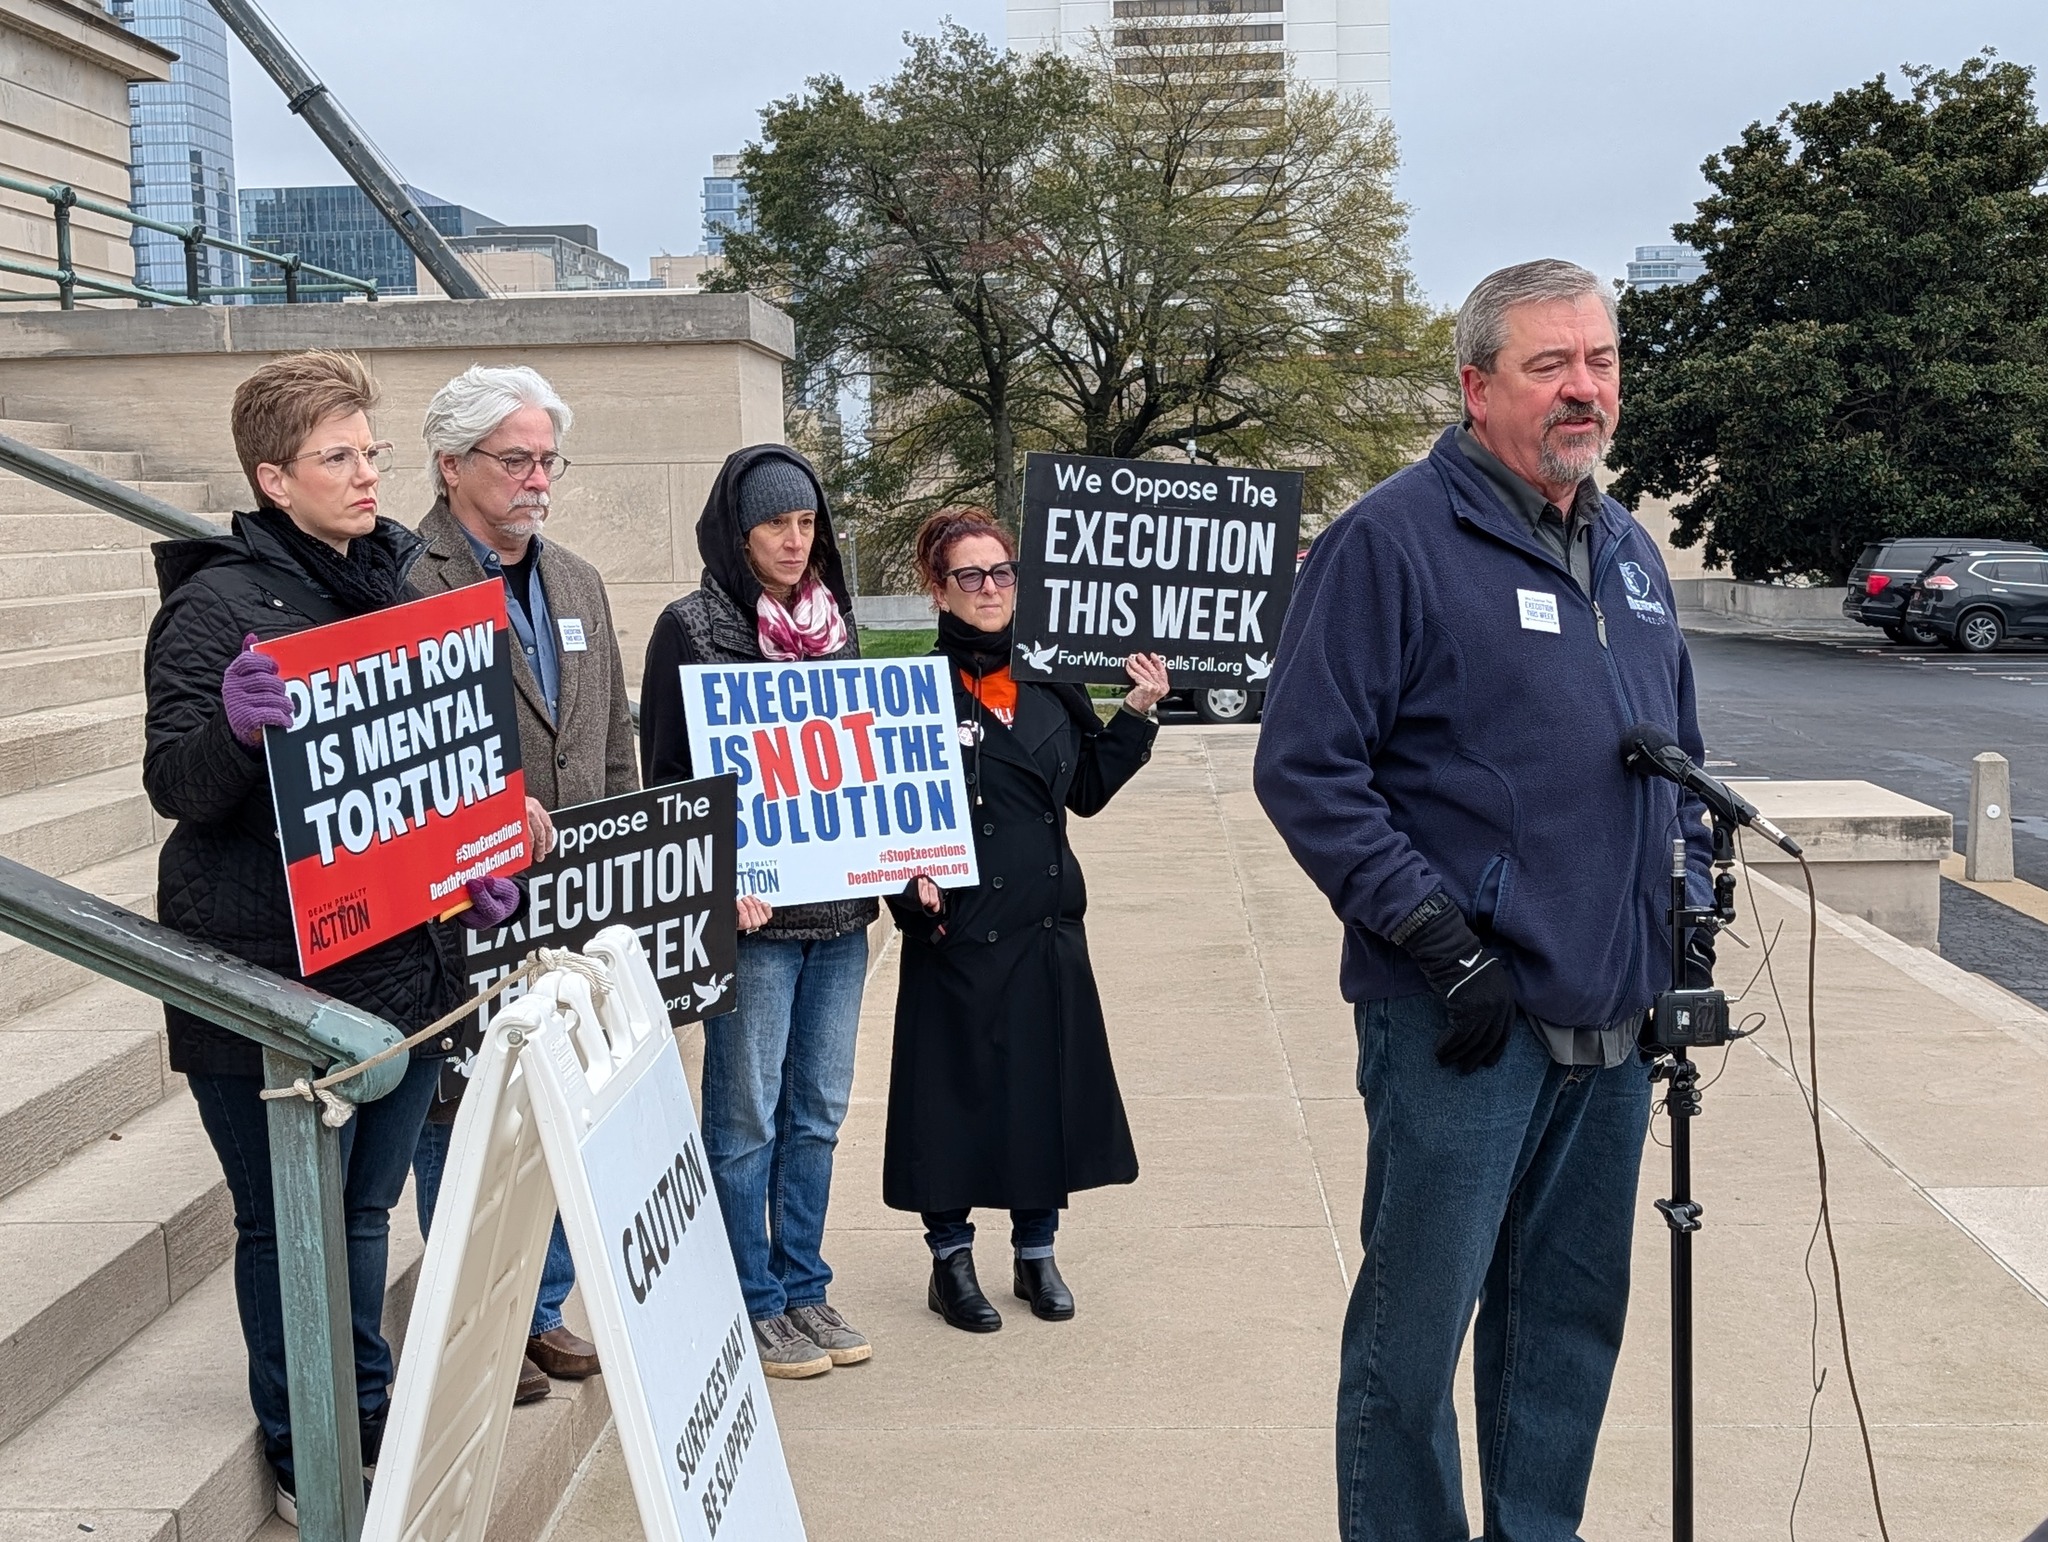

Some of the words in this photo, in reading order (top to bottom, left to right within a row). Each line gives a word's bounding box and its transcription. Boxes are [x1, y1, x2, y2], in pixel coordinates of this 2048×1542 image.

[1054, 463, 1102, 493] We
[1111, 468, 1218, 504] Oppose
[1227, 476, 1277, 507] The
[1044, 508, 1276, 576] EXECUTION
[1044, 579, 1139, 637] THIS
[1152, 585, 1268, 643] WEEK
[285, 646, 411, 733] DEATH
[419, 620, 495, 690] ROW
[701, 664, 940, 726] EXECUTION
[305, 733, 345, 791] IS
[351, 684, 494, 775] MENTAL
[709, 735, 753, 786] IS
[752, 711, 878, 801] NOT
[875, 724, 949, 774] THE
[304, 734, 507, 865] TORTURE
[552, 810, 648, 858] ppose
[657, 793, 710, 825] The
[430, 842, 524, 900] DeathPenaltyAction.org
[455, 820, 522, 864] #StopExecutions
[879, 844, 966, 863] #StopExecutions
[308, 902, 332, 918] DEATH
[335, 887, 366, 907] PENALTY
[310, 898, 371, 955] ACTION
[622, 1132, 707, 1304] CAUTION
[676, 1355, 729, 1491] SURFACES
[723, 1312, 747, 1387] MAY
[702, 1477, 722, 1541] BE
[715, 1383, 758, 1508] SLIPPERY
